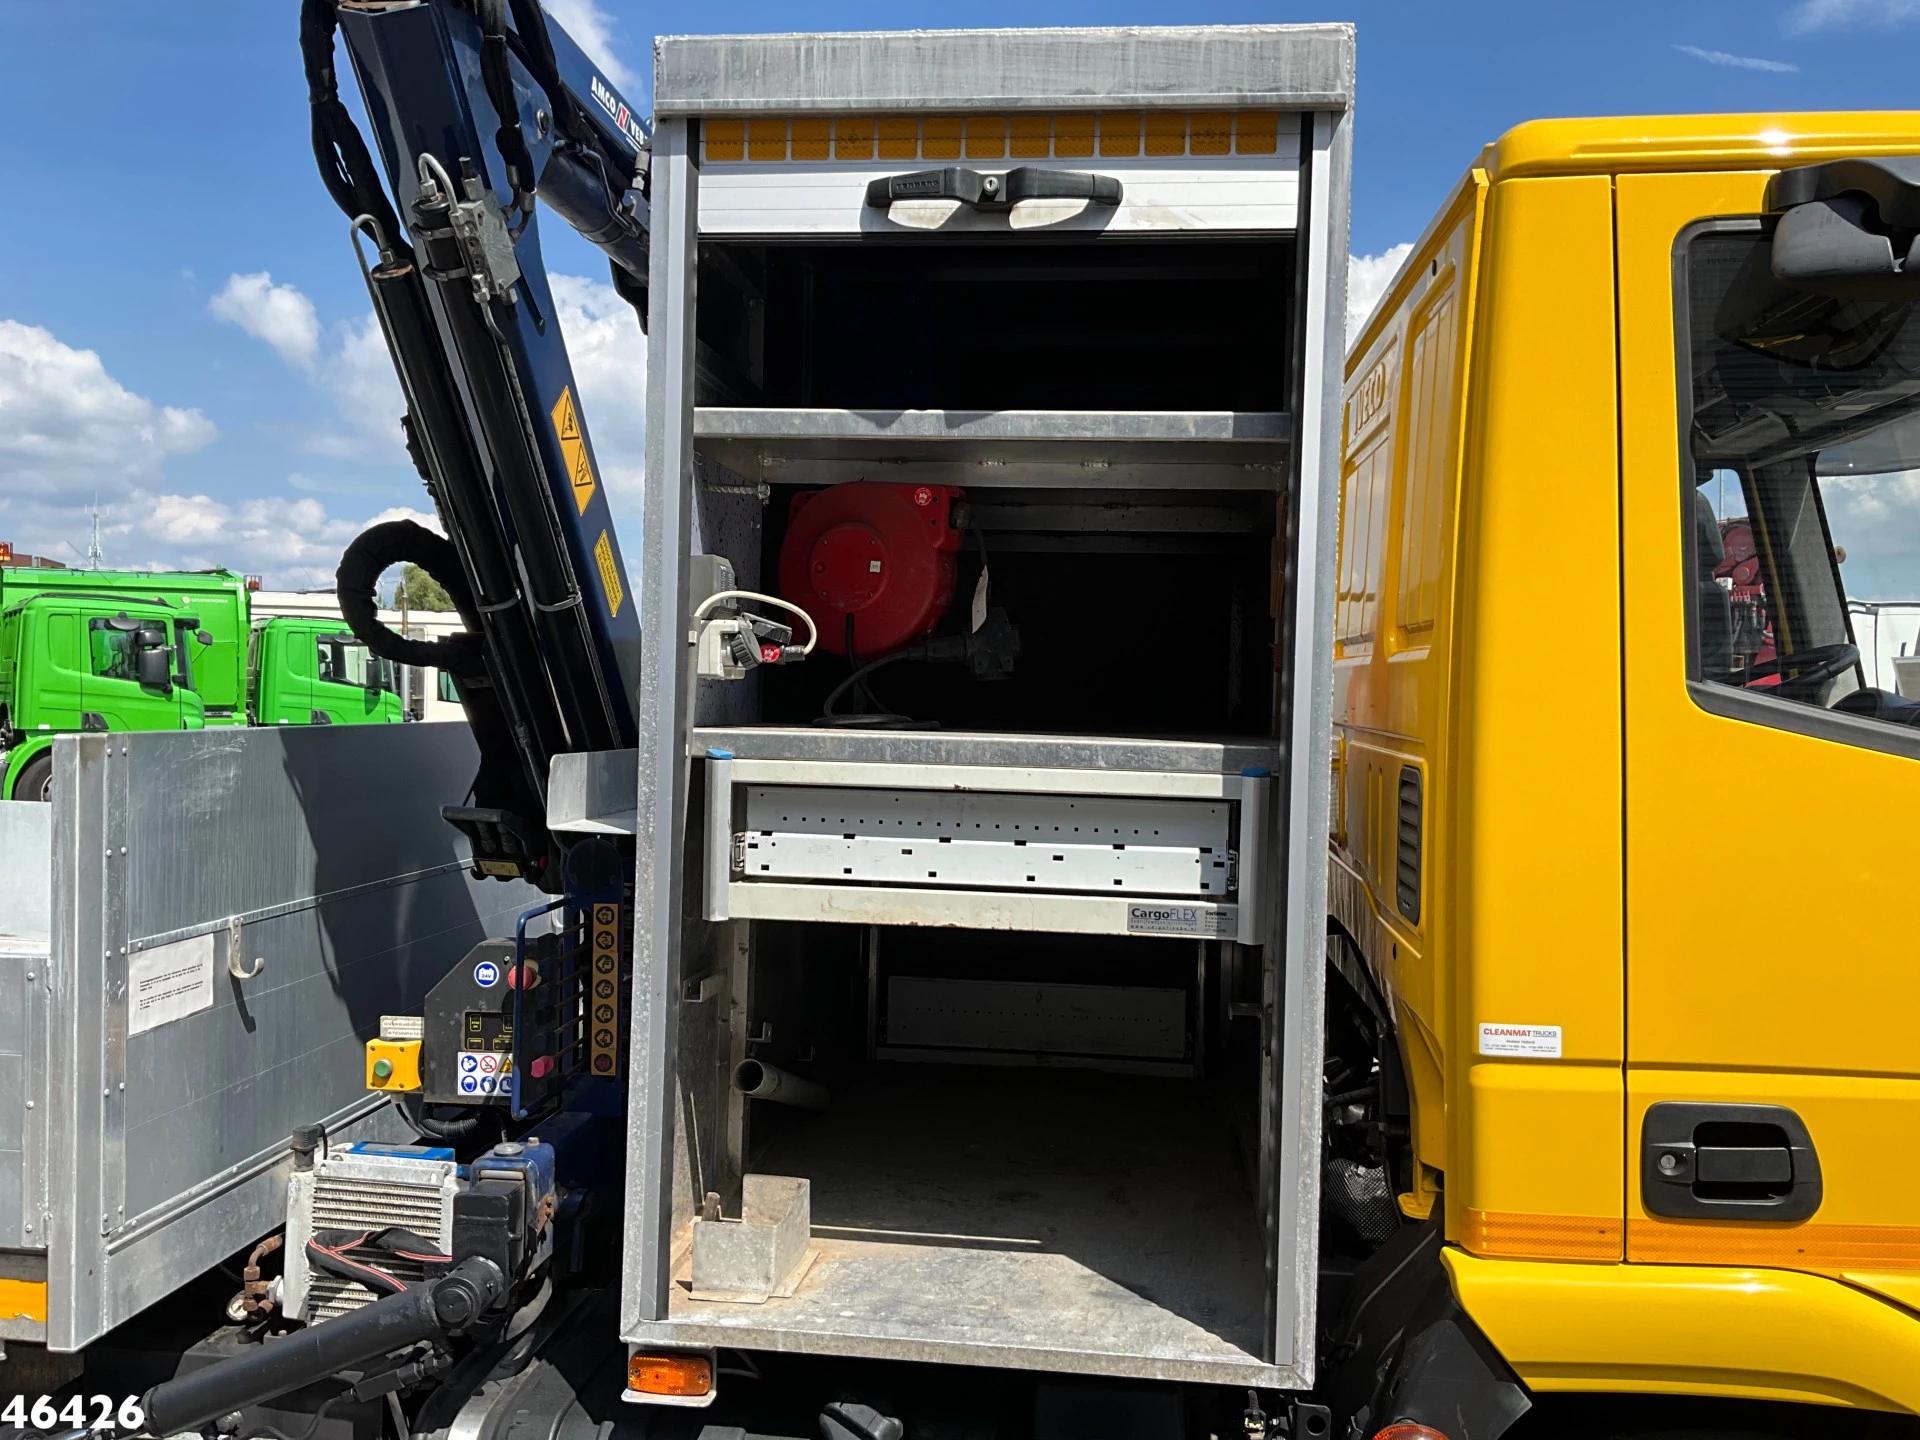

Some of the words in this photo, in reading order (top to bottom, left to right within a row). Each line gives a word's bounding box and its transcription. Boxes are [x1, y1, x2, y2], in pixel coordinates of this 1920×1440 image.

[591, 75, 616, 114] AMCO
[630, 119, 648, 145] VEB
[1131, 907, 1197, 920] CargoFLEX
[1484, 1028, 1531, 1037] CLEANMAT
